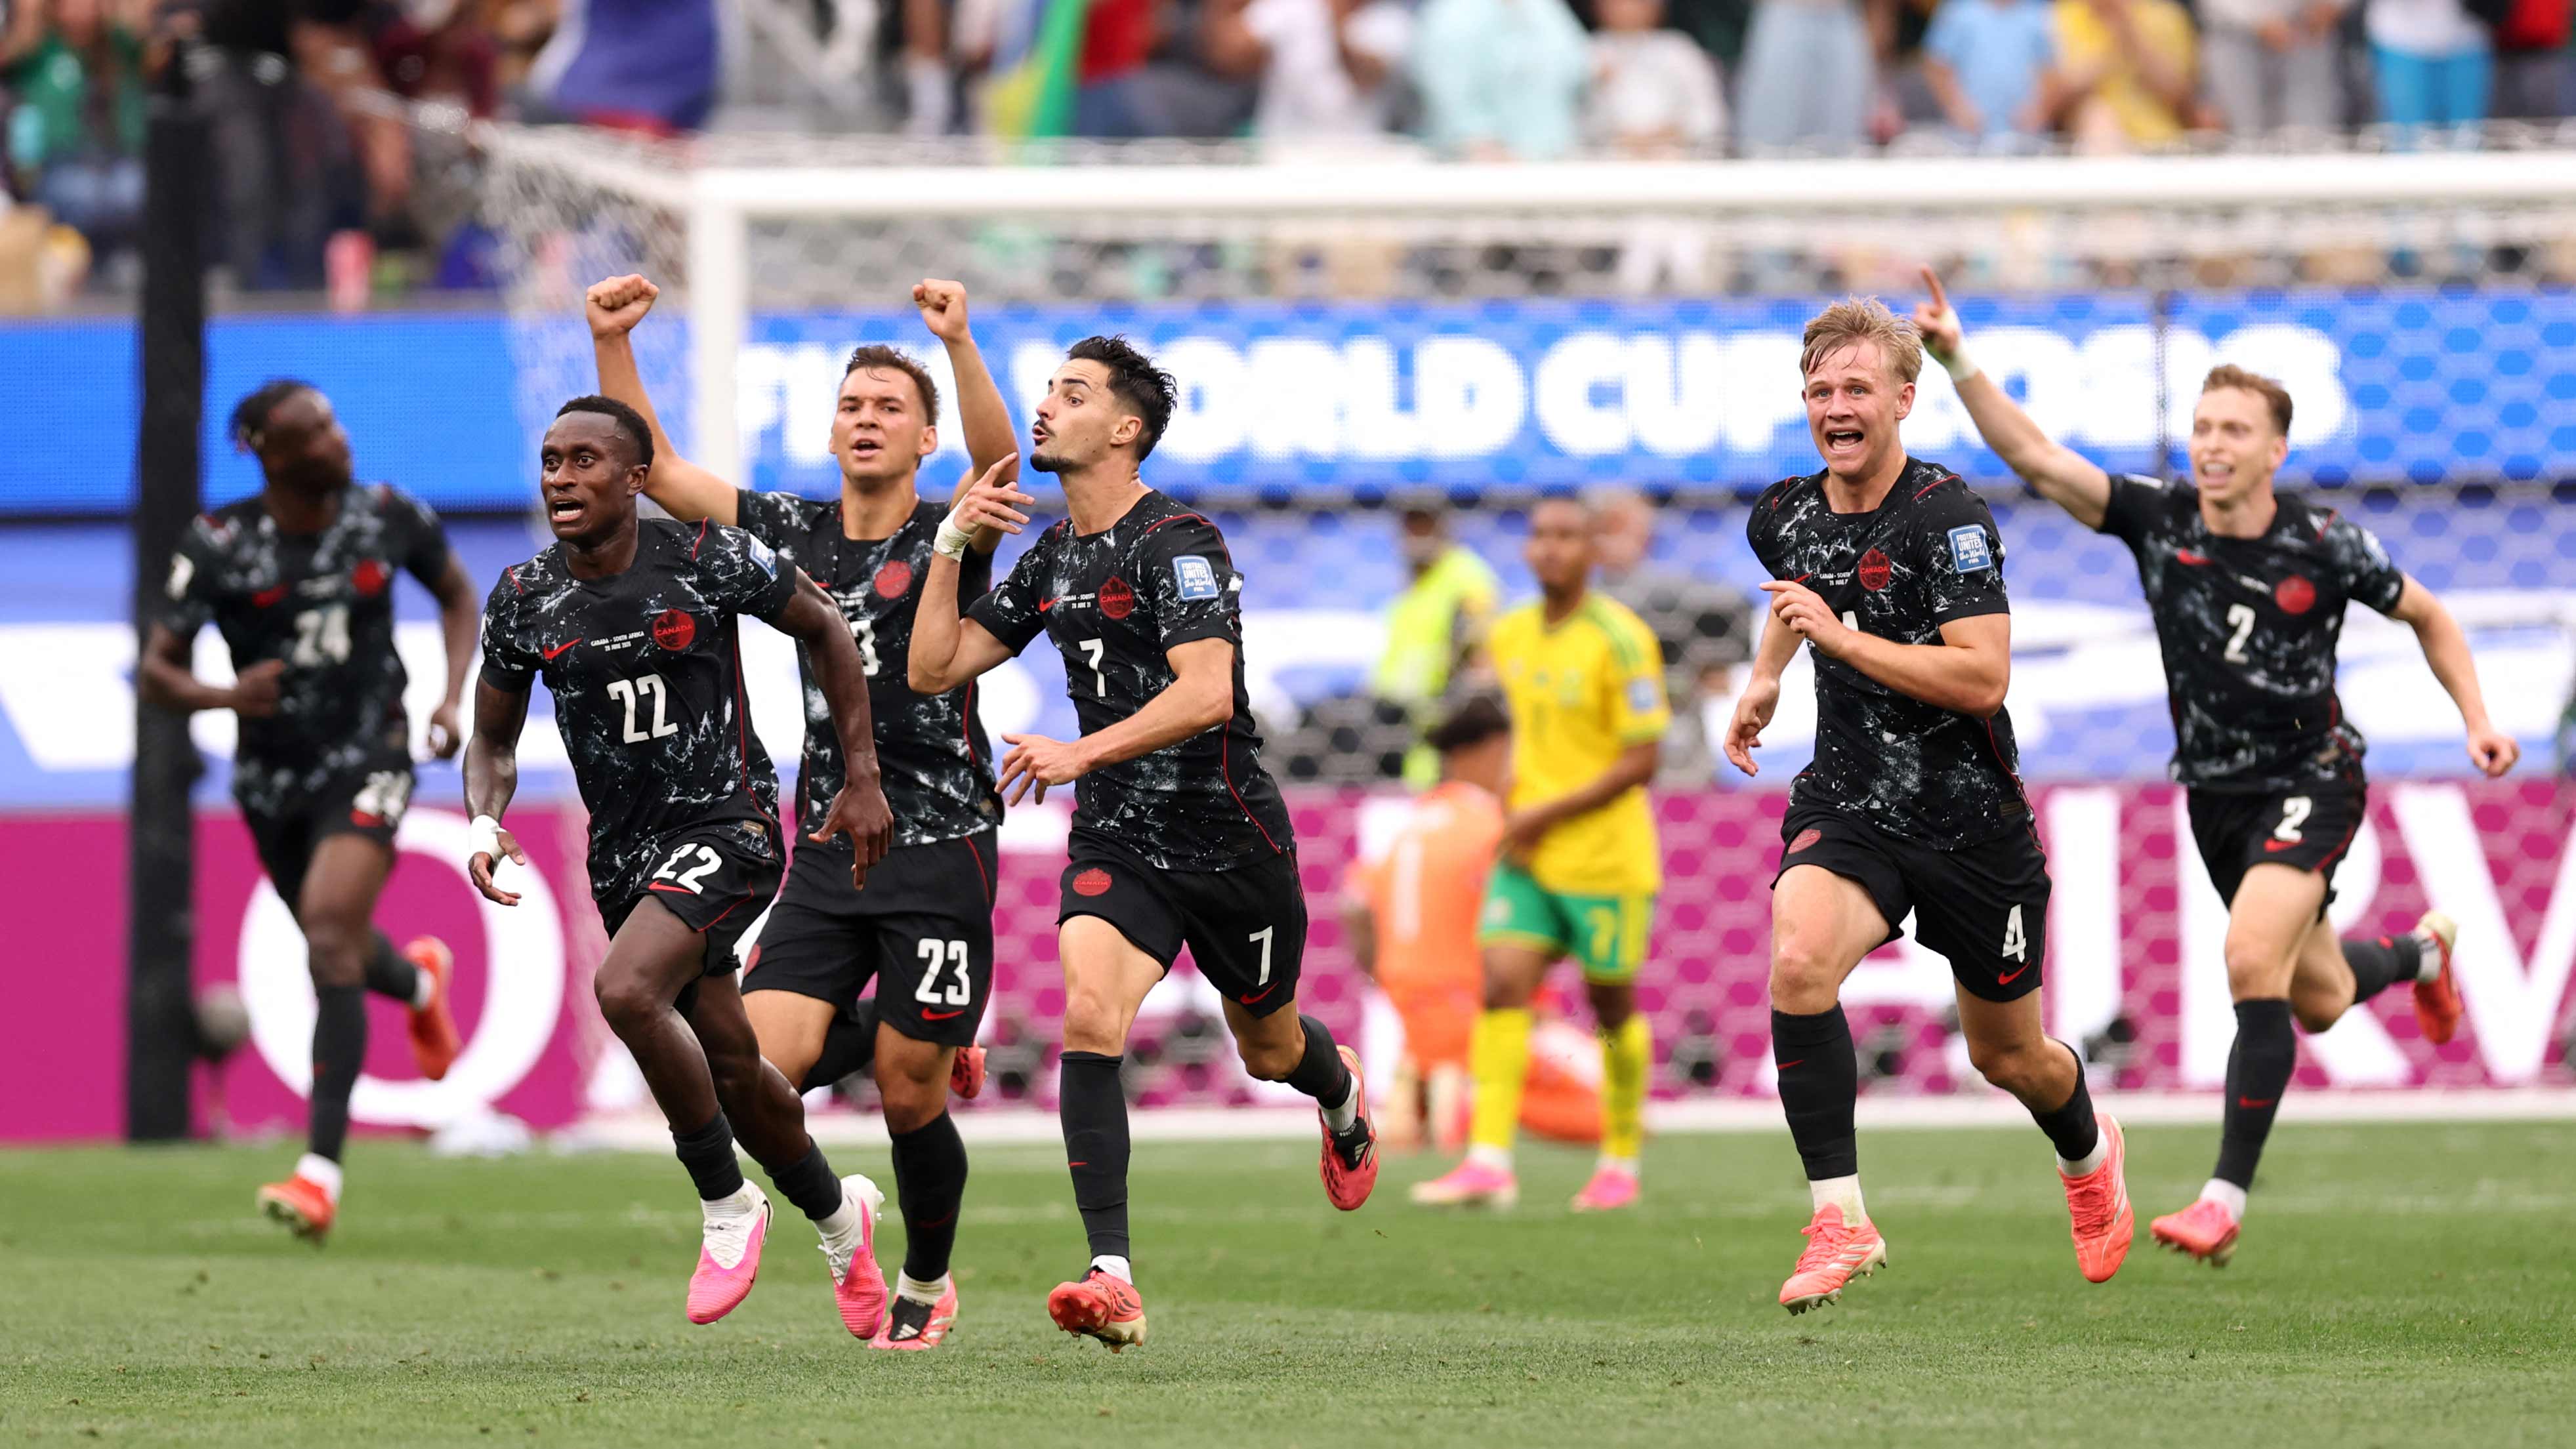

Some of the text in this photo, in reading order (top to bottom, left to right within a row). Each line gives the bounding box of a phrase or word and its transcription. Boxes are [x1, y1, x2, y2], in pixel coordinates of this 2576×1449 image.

[1535, 331, 1808, 455] CUP
[1958, 539, 1982, 551] UNITES
[1101, 594, 1131, 603] CANADA
[656, 624, 693, 636] CANADA
[849, 619, 879, 676] 3
[2224, 603, 2256, 664] 2
[1079, 638, 1106, 697] 7
[606, 674, 679, 744] 22
[2274, 796, 2312, 843] 2
[652, 842, 722, 895] 22
[1249, 925, 1273, 986] 7
[2003, 903, 2026, 963] 4
[915, 937, 970, 1006] 23
